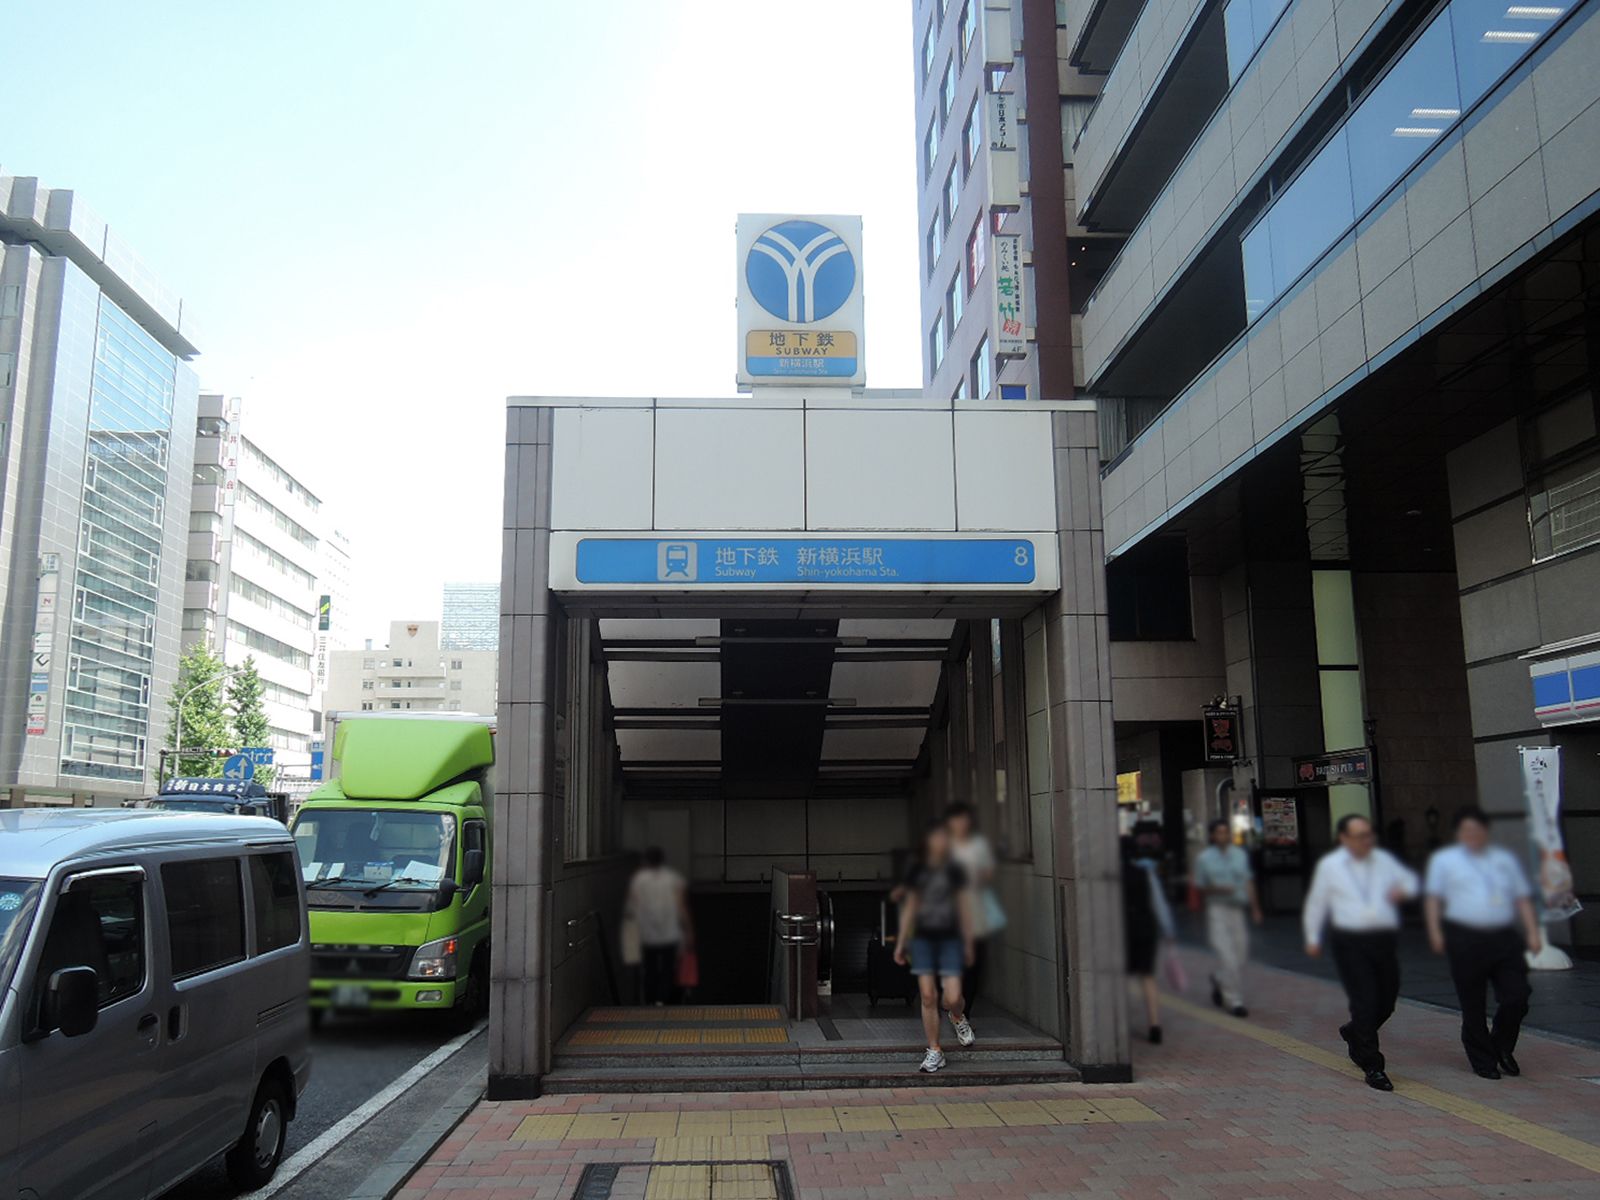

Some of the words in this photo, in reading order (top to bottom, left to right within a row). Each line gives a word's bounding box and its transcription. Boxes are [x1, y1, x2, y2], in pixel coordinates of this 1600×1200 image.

[769, 332, 835, 347] 地下鉄
[776, 347, 828, 355] SUBWAY
[715, 547, 779, 566] 地下鉄
[797, 547, 883, 566] 新横浜駅
[1015, 546, 1028, 566] 8
[715, 567, 757, 578] Subway
[797, 567, 878, 578] Shin-yokohama
[880, 567, 900, 577] Sta.
[317, 636, 327, 686] 三井住友銀行
